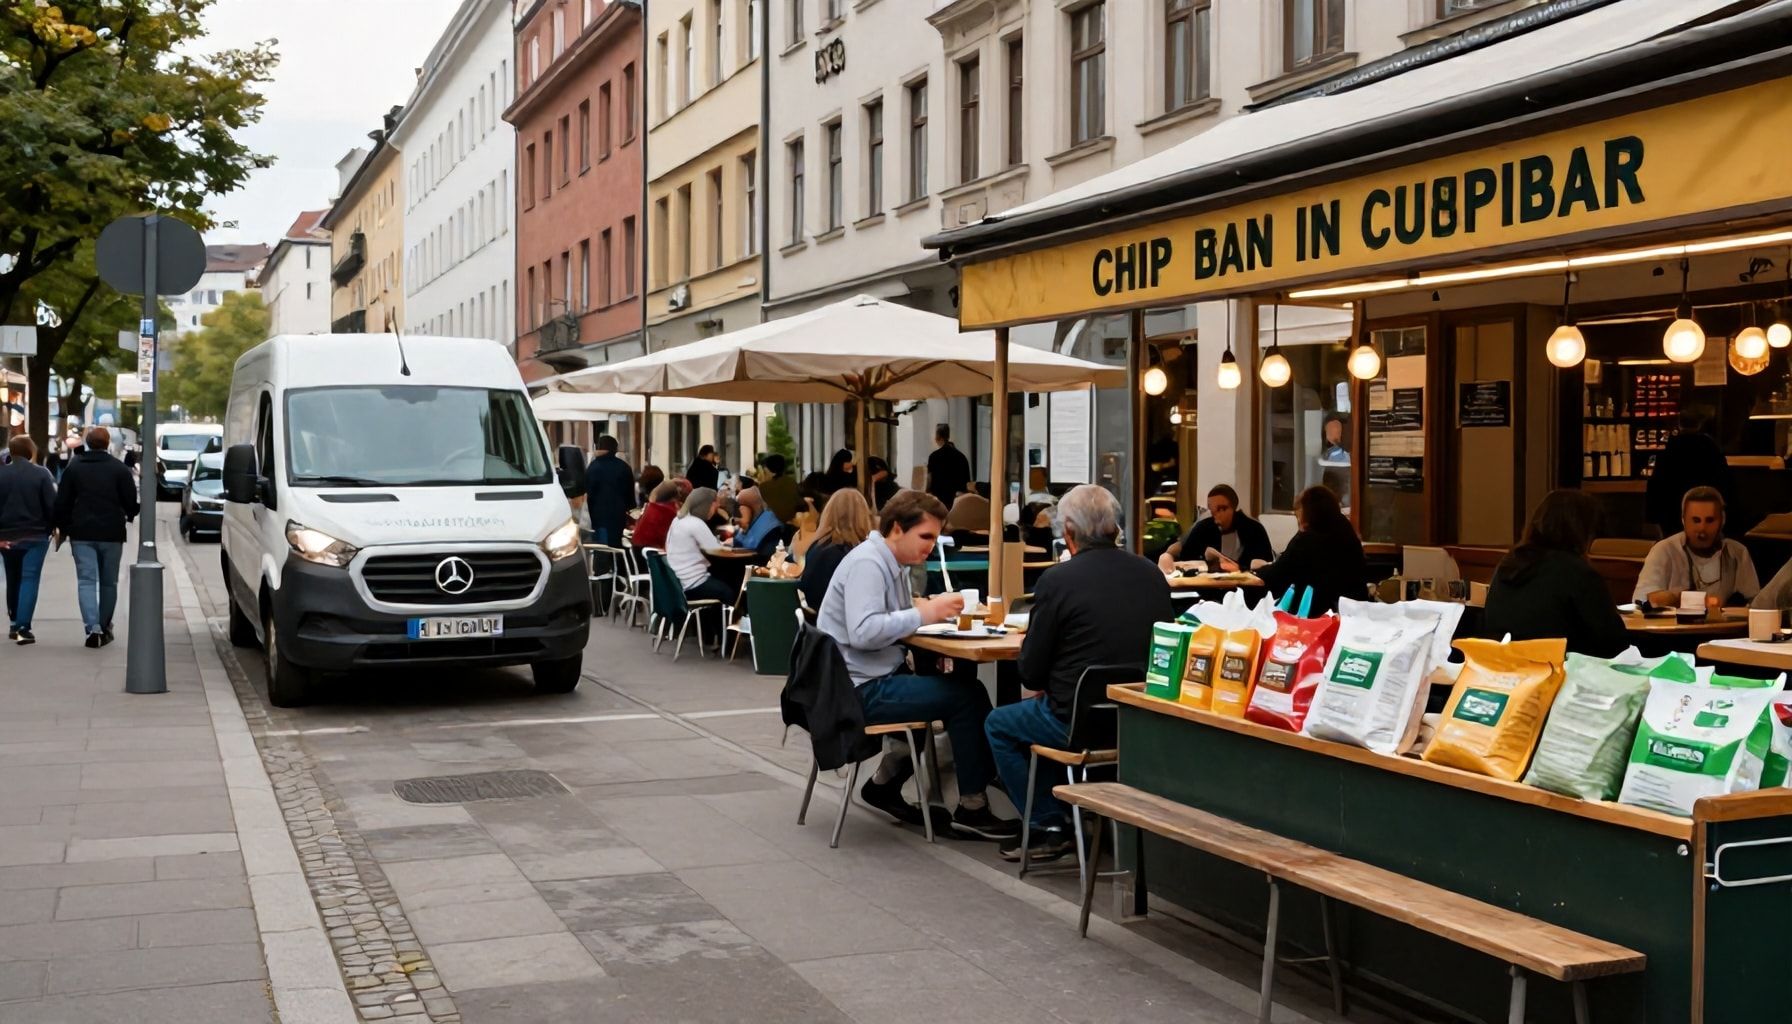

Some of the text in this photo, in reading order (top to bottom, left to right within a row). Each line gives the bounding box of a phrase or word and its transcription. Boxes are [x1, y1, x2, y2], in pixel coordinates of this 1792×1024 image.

[1093, 237, 1172, 296] CHIP
[1195, 214, 1273, 280] BAN
[1297, 200, 1341, 261] IN
